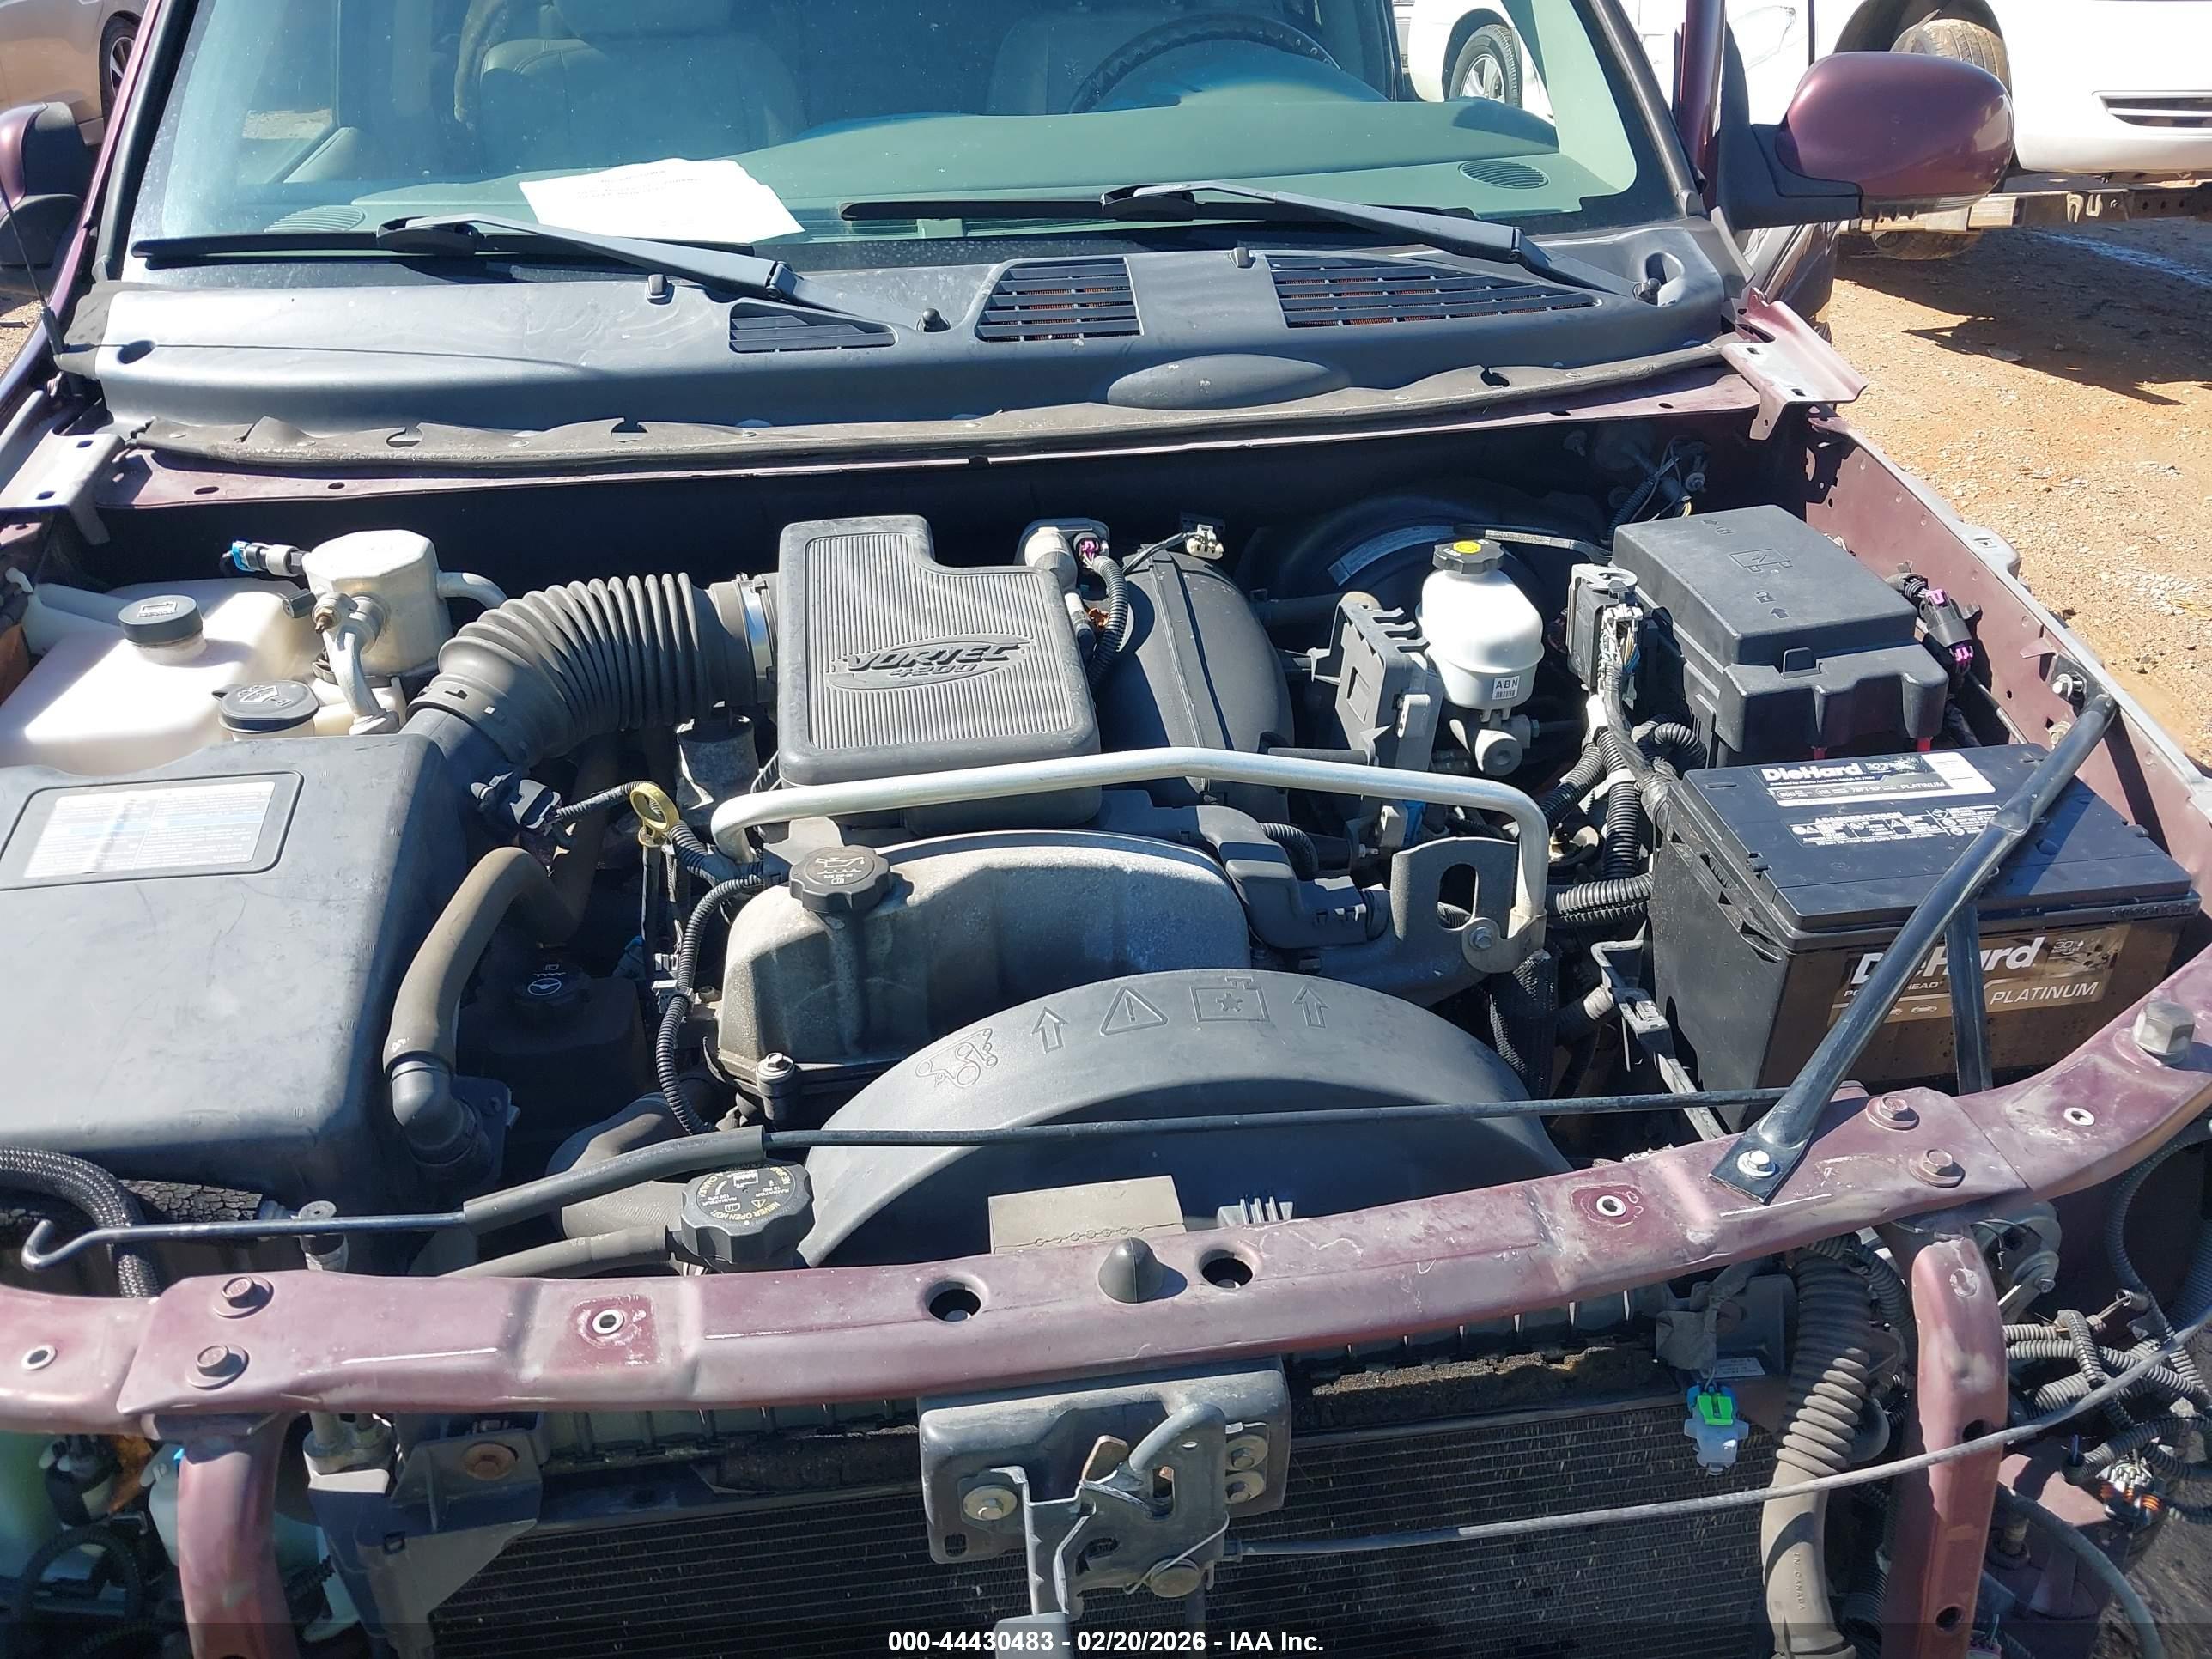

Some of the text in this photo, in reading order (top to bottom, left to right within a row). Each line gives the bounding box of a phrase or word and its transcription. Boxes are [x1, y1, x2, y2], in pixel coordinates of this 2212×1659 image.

[844, 643, 1020, 672] VORTEC
[890, 664, 977, 678] 4200
[1495, 679, 1518, 689] ABN
[1761, 763, 1863, 781] DieHard
[1990, 981, 2099, 1006] PLATINUM
[728, 1212, 753, 1220] OPEN
[751, 1201, 781, 1217] NEVER
